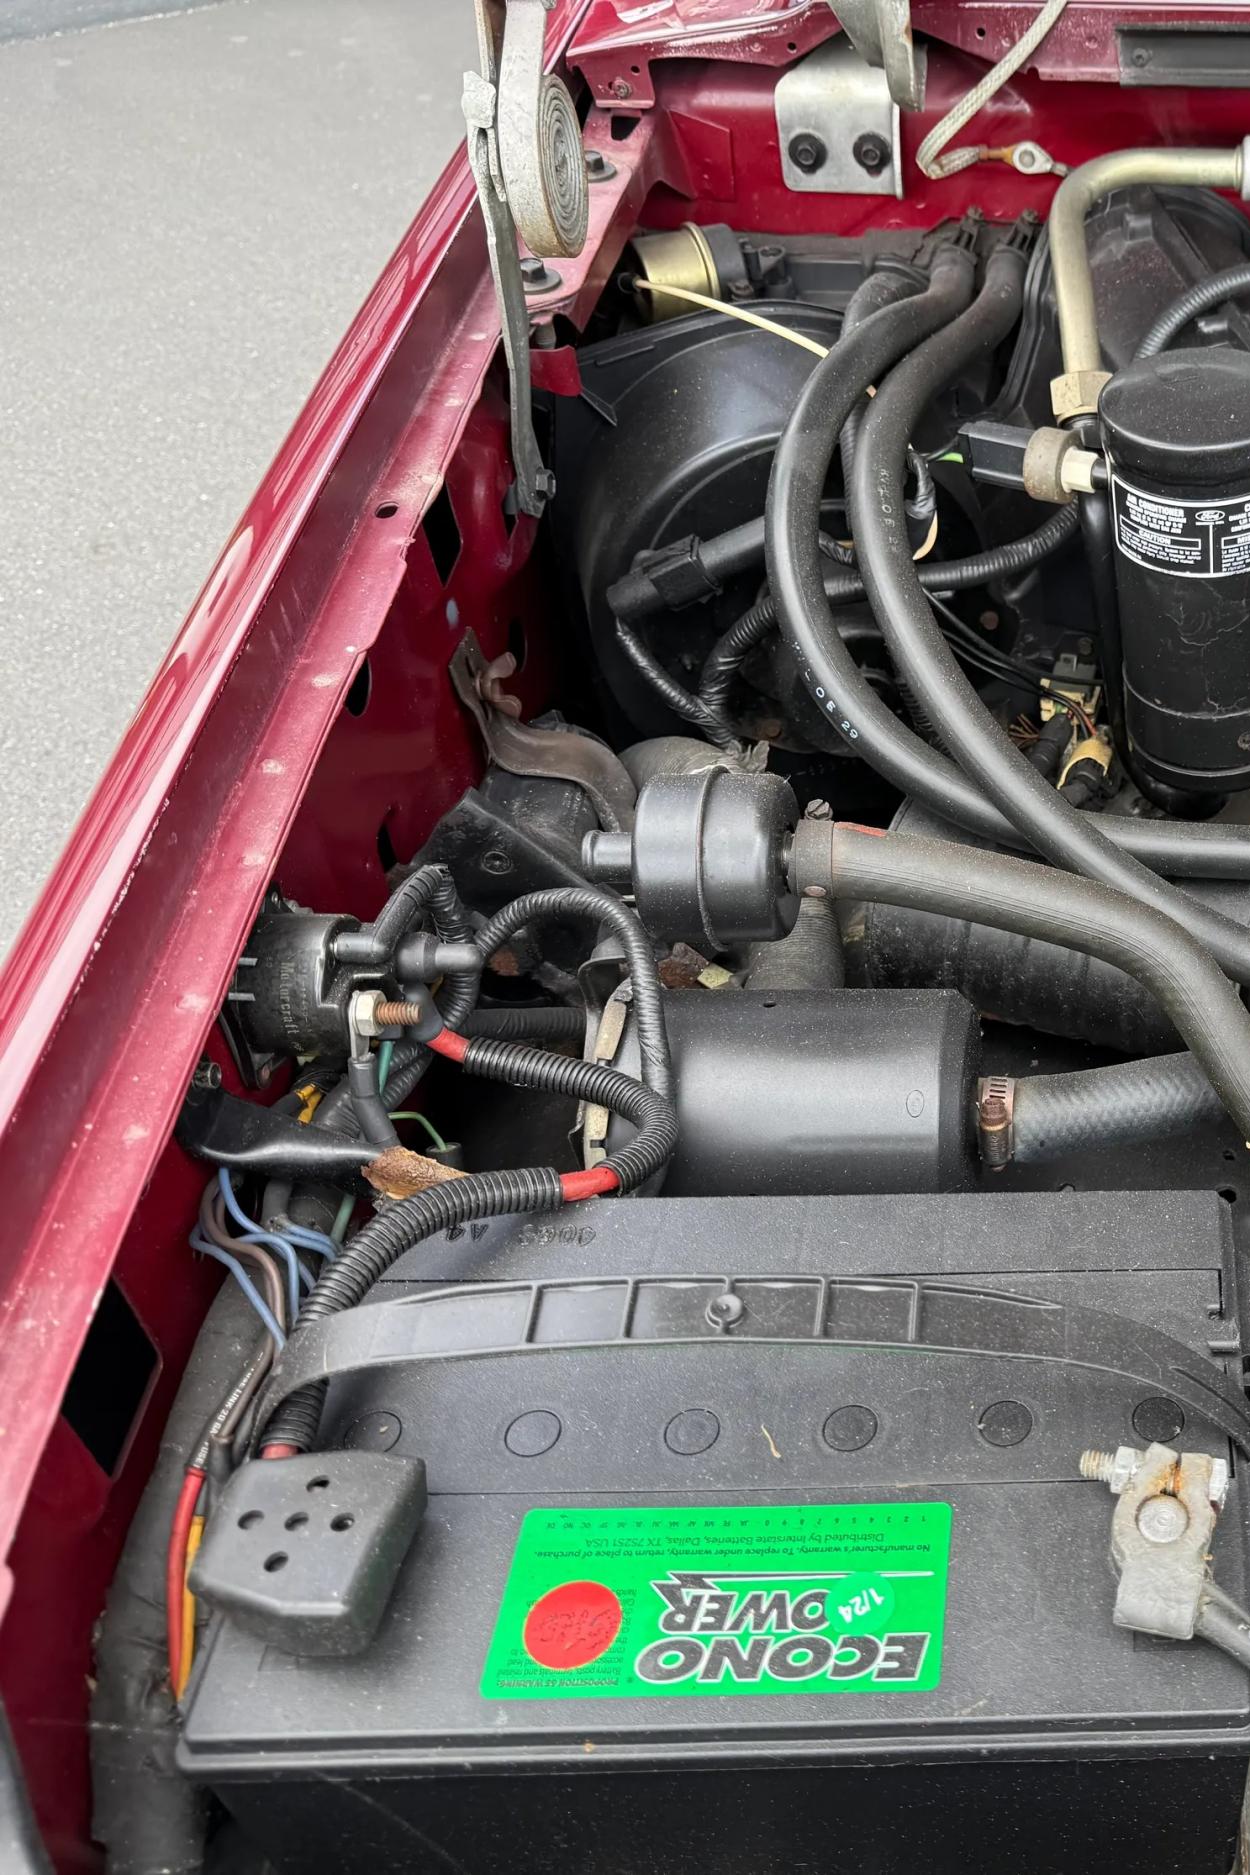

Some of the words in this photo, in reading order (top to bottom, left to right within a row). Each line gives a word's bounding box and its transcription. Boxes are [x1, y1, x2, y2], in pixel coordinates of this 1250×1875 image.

[1138, 497, 1185, 518] CONDITIONER
[1197, 510, 1223, 522] Ford
[1138, 529, 1171, 545] CAUTION
[280, 962, 301, 1034] Motorcraft
[225, 1389, 242, 1409] LINK
[585, 1538, 609, 1548] USA
[612, 1537, 645, 1548] 75251
[646, 1537, 662, 1547] TX
[664, 1536, 701, 1548] Dallas,
[703, 1535, 754, 1547] Batteries,
[756, 1535, 807, 1545] Interstate
[809, 1533, 822, 1544] by
[824, 1532, 885, 1544] Distributed
[582, 1550, 594, 1560] of
[595, 1549, 622, 1560] place
[622, 1549, 634, 1558] to
[634, 1549, 665, 1558] return
[667, 1547, 713, 1558] warranty,
[714, 1547, 744, 1556] under
[745, 1546, 781, 1556] replace
[781, 1547, 795, 1556] To
[797, 1545, 843, 1557] warranty.
[843, 1544, 915, 1557] manufacturer's
[916, 1545, 931, 1555] No
[650, 1580, 831, 1633] OWER
[837, 1585, 885, 1623] 1/24
[635, 1632, 931, 1684] ECONO
